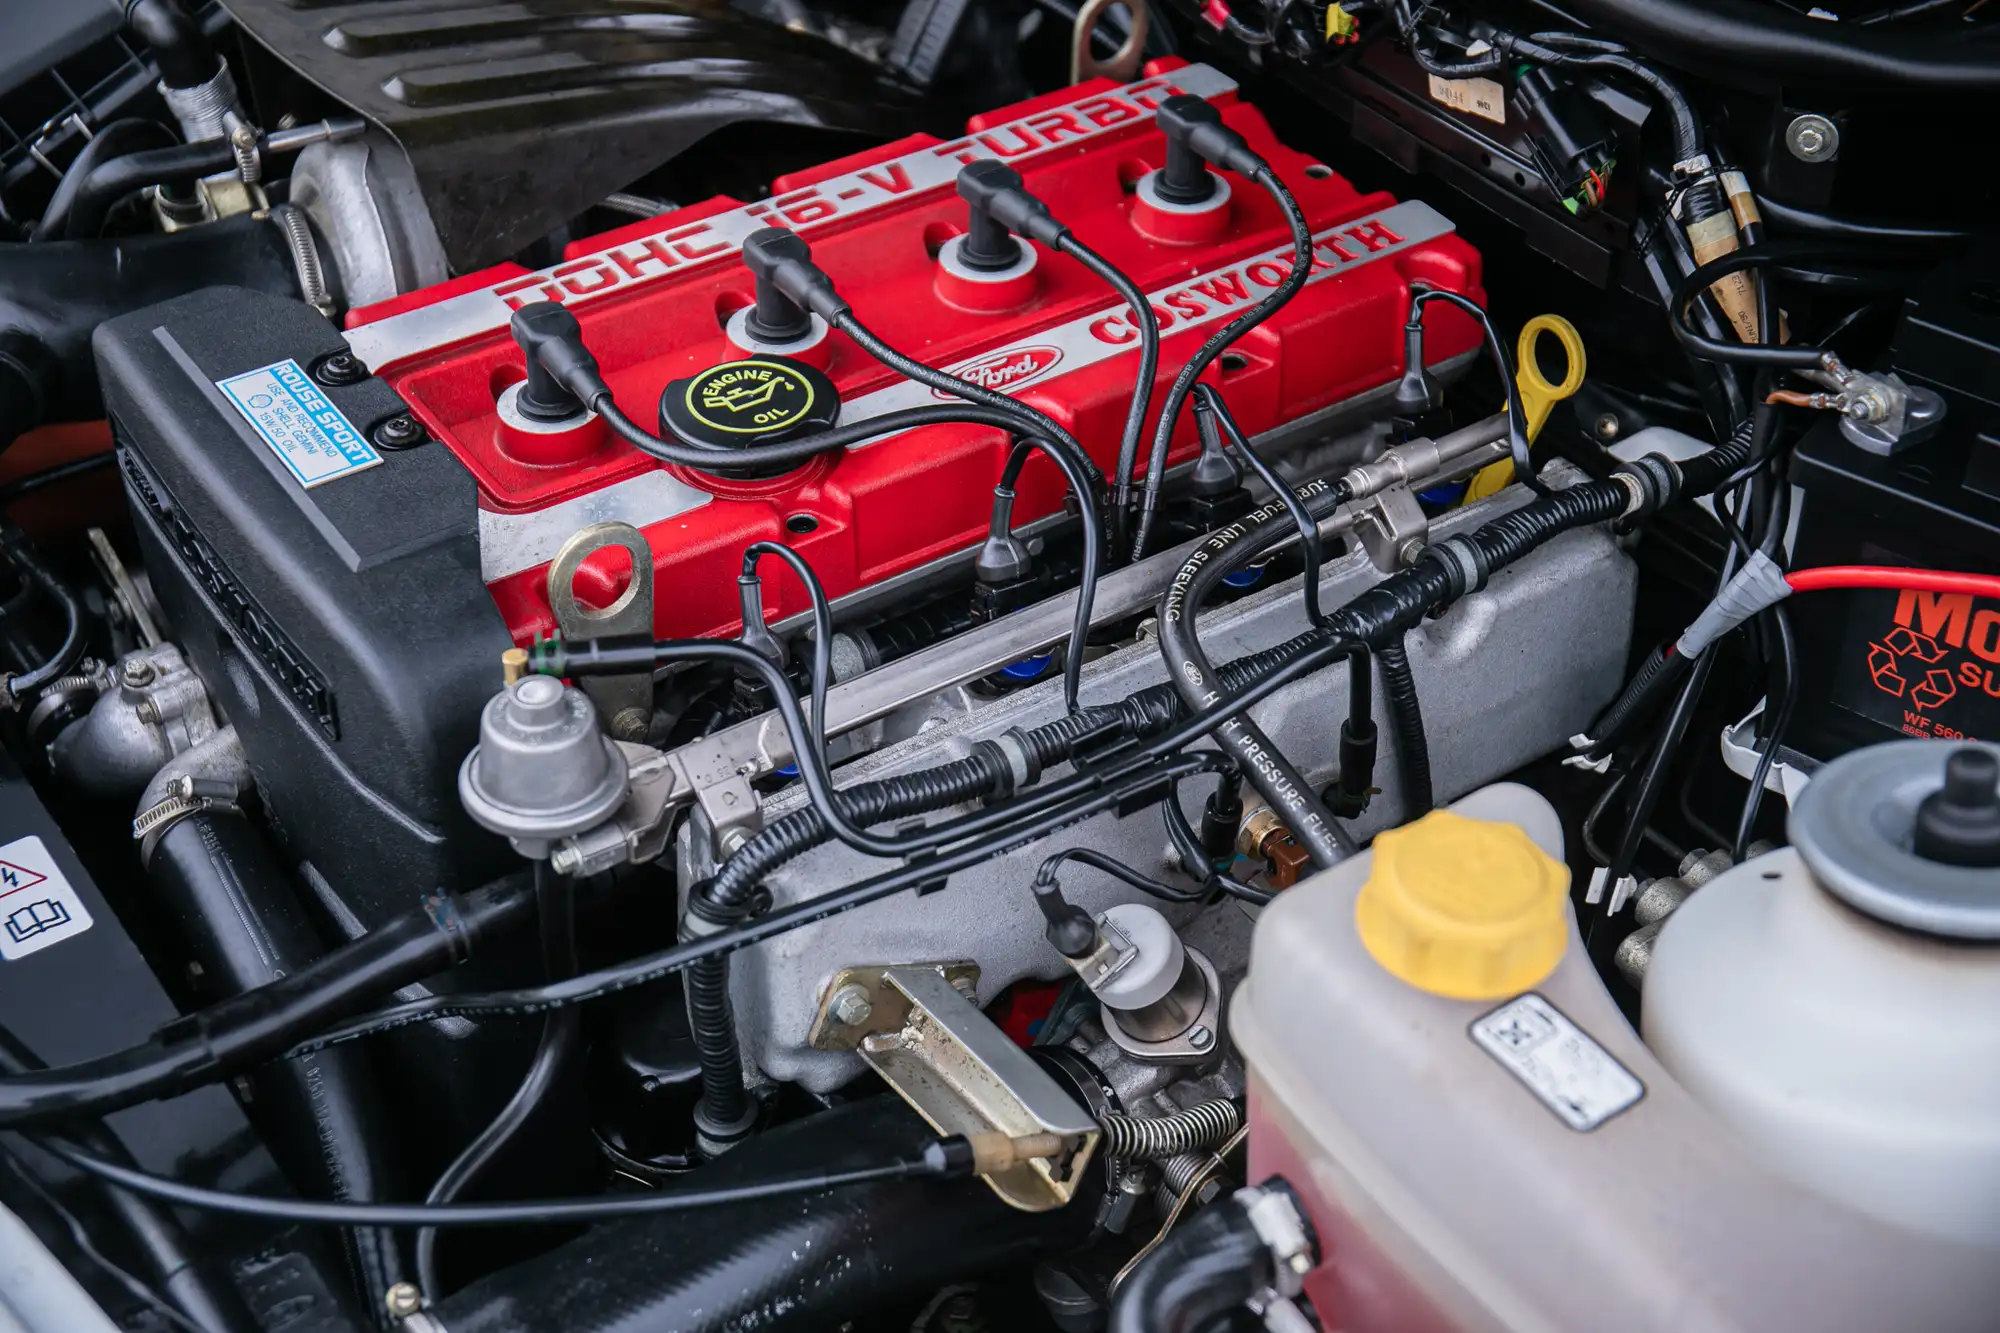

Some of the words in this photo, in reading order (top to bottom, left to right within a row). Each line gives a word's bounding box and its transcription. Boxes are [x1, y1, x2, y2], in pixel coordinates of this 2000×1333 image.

[493, 223, 733, 310] DOHC
[1089, 219, 1406, 345] COSWORTH
[1205, 329, 1229, 351] BERU
[703, 370, 773, 397] ENGINE
[961, 354, 1039, 387] Ford
[1173, 364, 1194, 392] BERU
[267, 382, 285, 397] USE
[281, 398, 299, 413] AND
[294, 413, 338, 458] RECOMMEND
[273, 363, 327, 413] ROUSE
[315, 411, 373, 462] SPORT
[754, 408, 789, 424] OIL
[930, 372, 963, 391] BERU
[987, 392, 1021, 411] BERU
[1042, 418, 1072, 444] BERU
[260, 412, 286, 438] 15W/50
[282, 439, 298, 453] OIL
[272, 408, 295, 430] SHELL
[291, 430, 318, 455] GEMINI
[1246, 500, 1287, 525] FUEL
[1208, 521, 1247, 549] LINE
[1166, 550, 1209, 622] SLEEVING
[1904, 709, 1932, 729] WF
[1933, 723, 1965, 743] 560
[1238, 734, 1306, 812] PRESSURE
